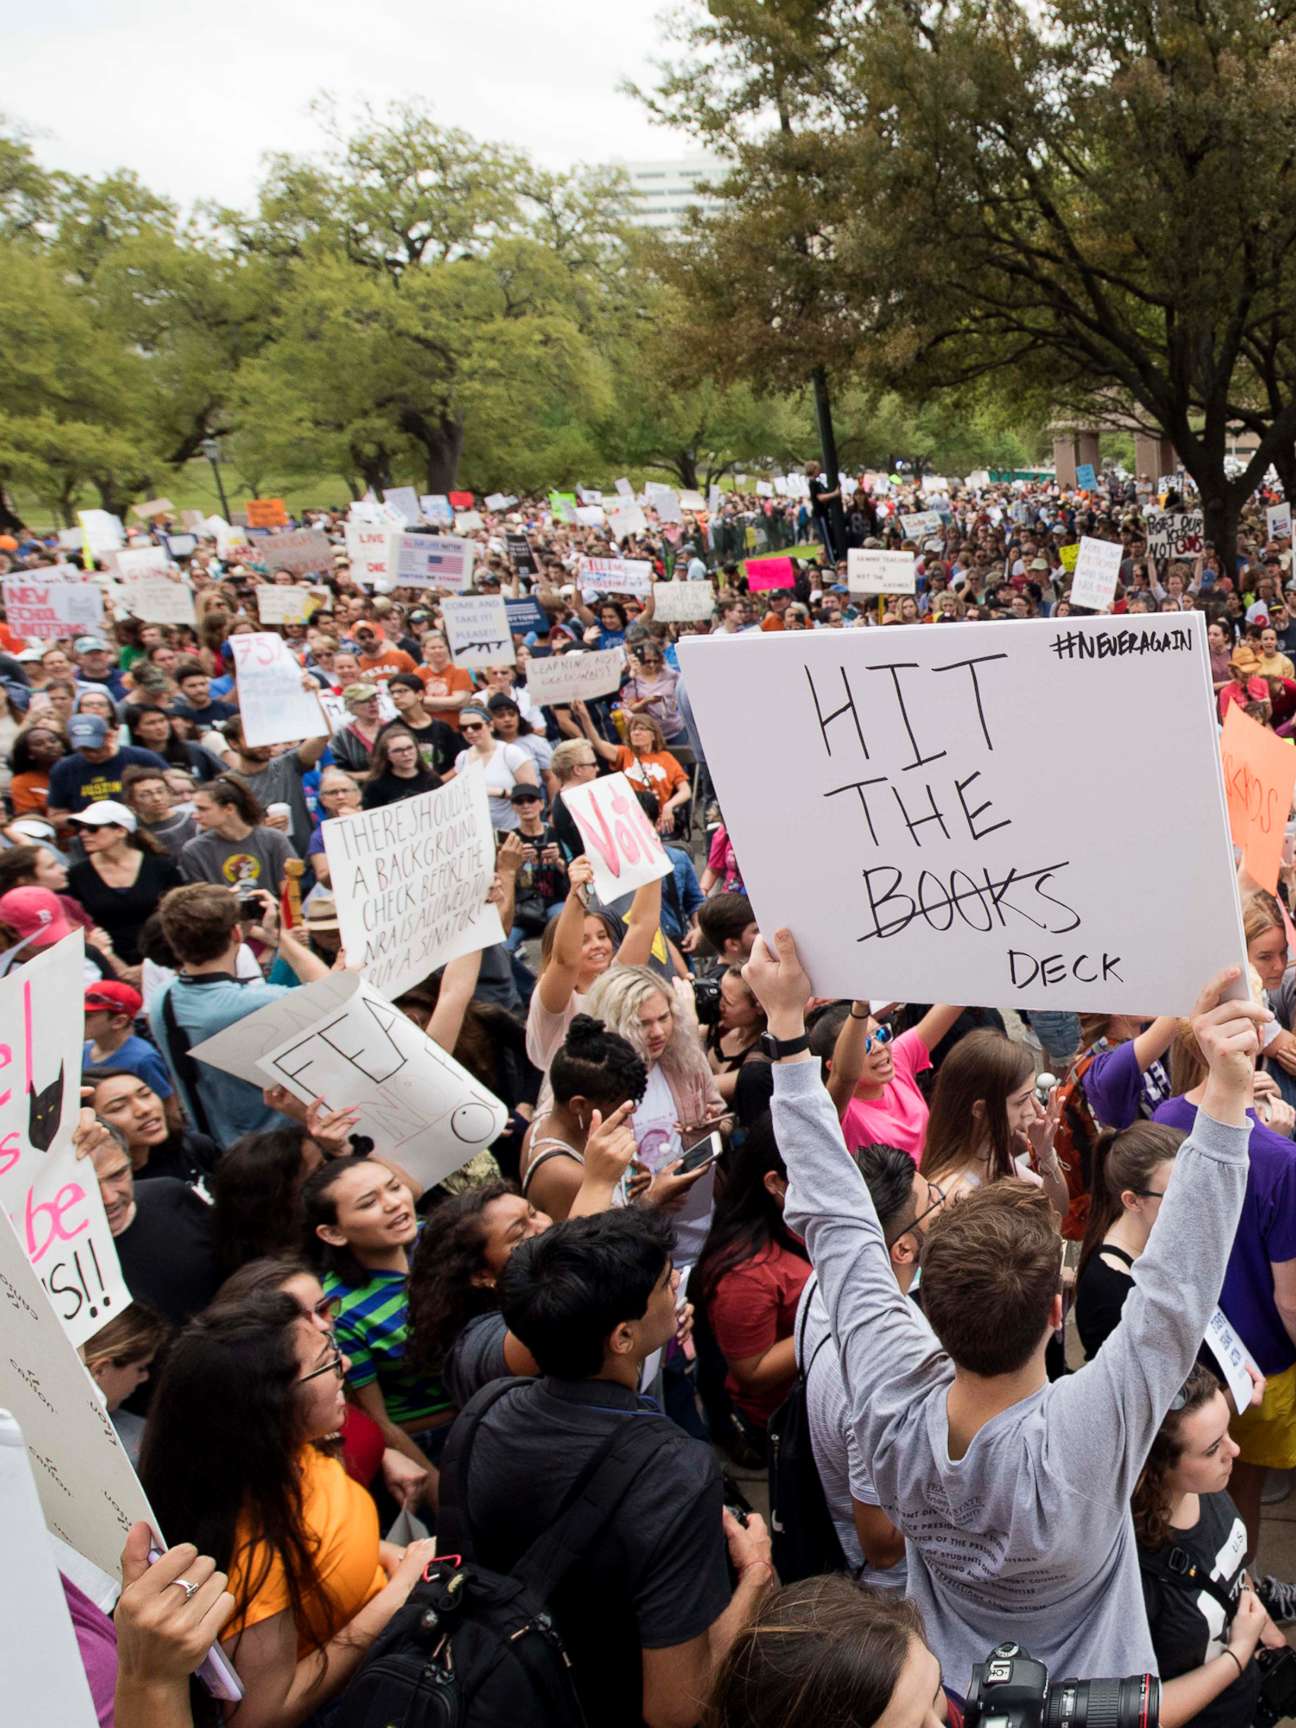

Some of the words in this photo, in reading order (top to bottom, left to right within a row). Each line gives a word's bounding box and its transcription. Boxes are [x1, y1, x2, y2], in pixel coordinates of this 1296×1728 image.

[804, 652, 1008, 771] HIT
[335, 804, 407, 860] THERE
[823, 771, 1012, 847] THE
[351, 865, 370, 900] A
[362, 881, 418, 933] CHECK
[858, 862, 1081, 942] BOOKS
[1007, 949, 1125, 990] DECK
